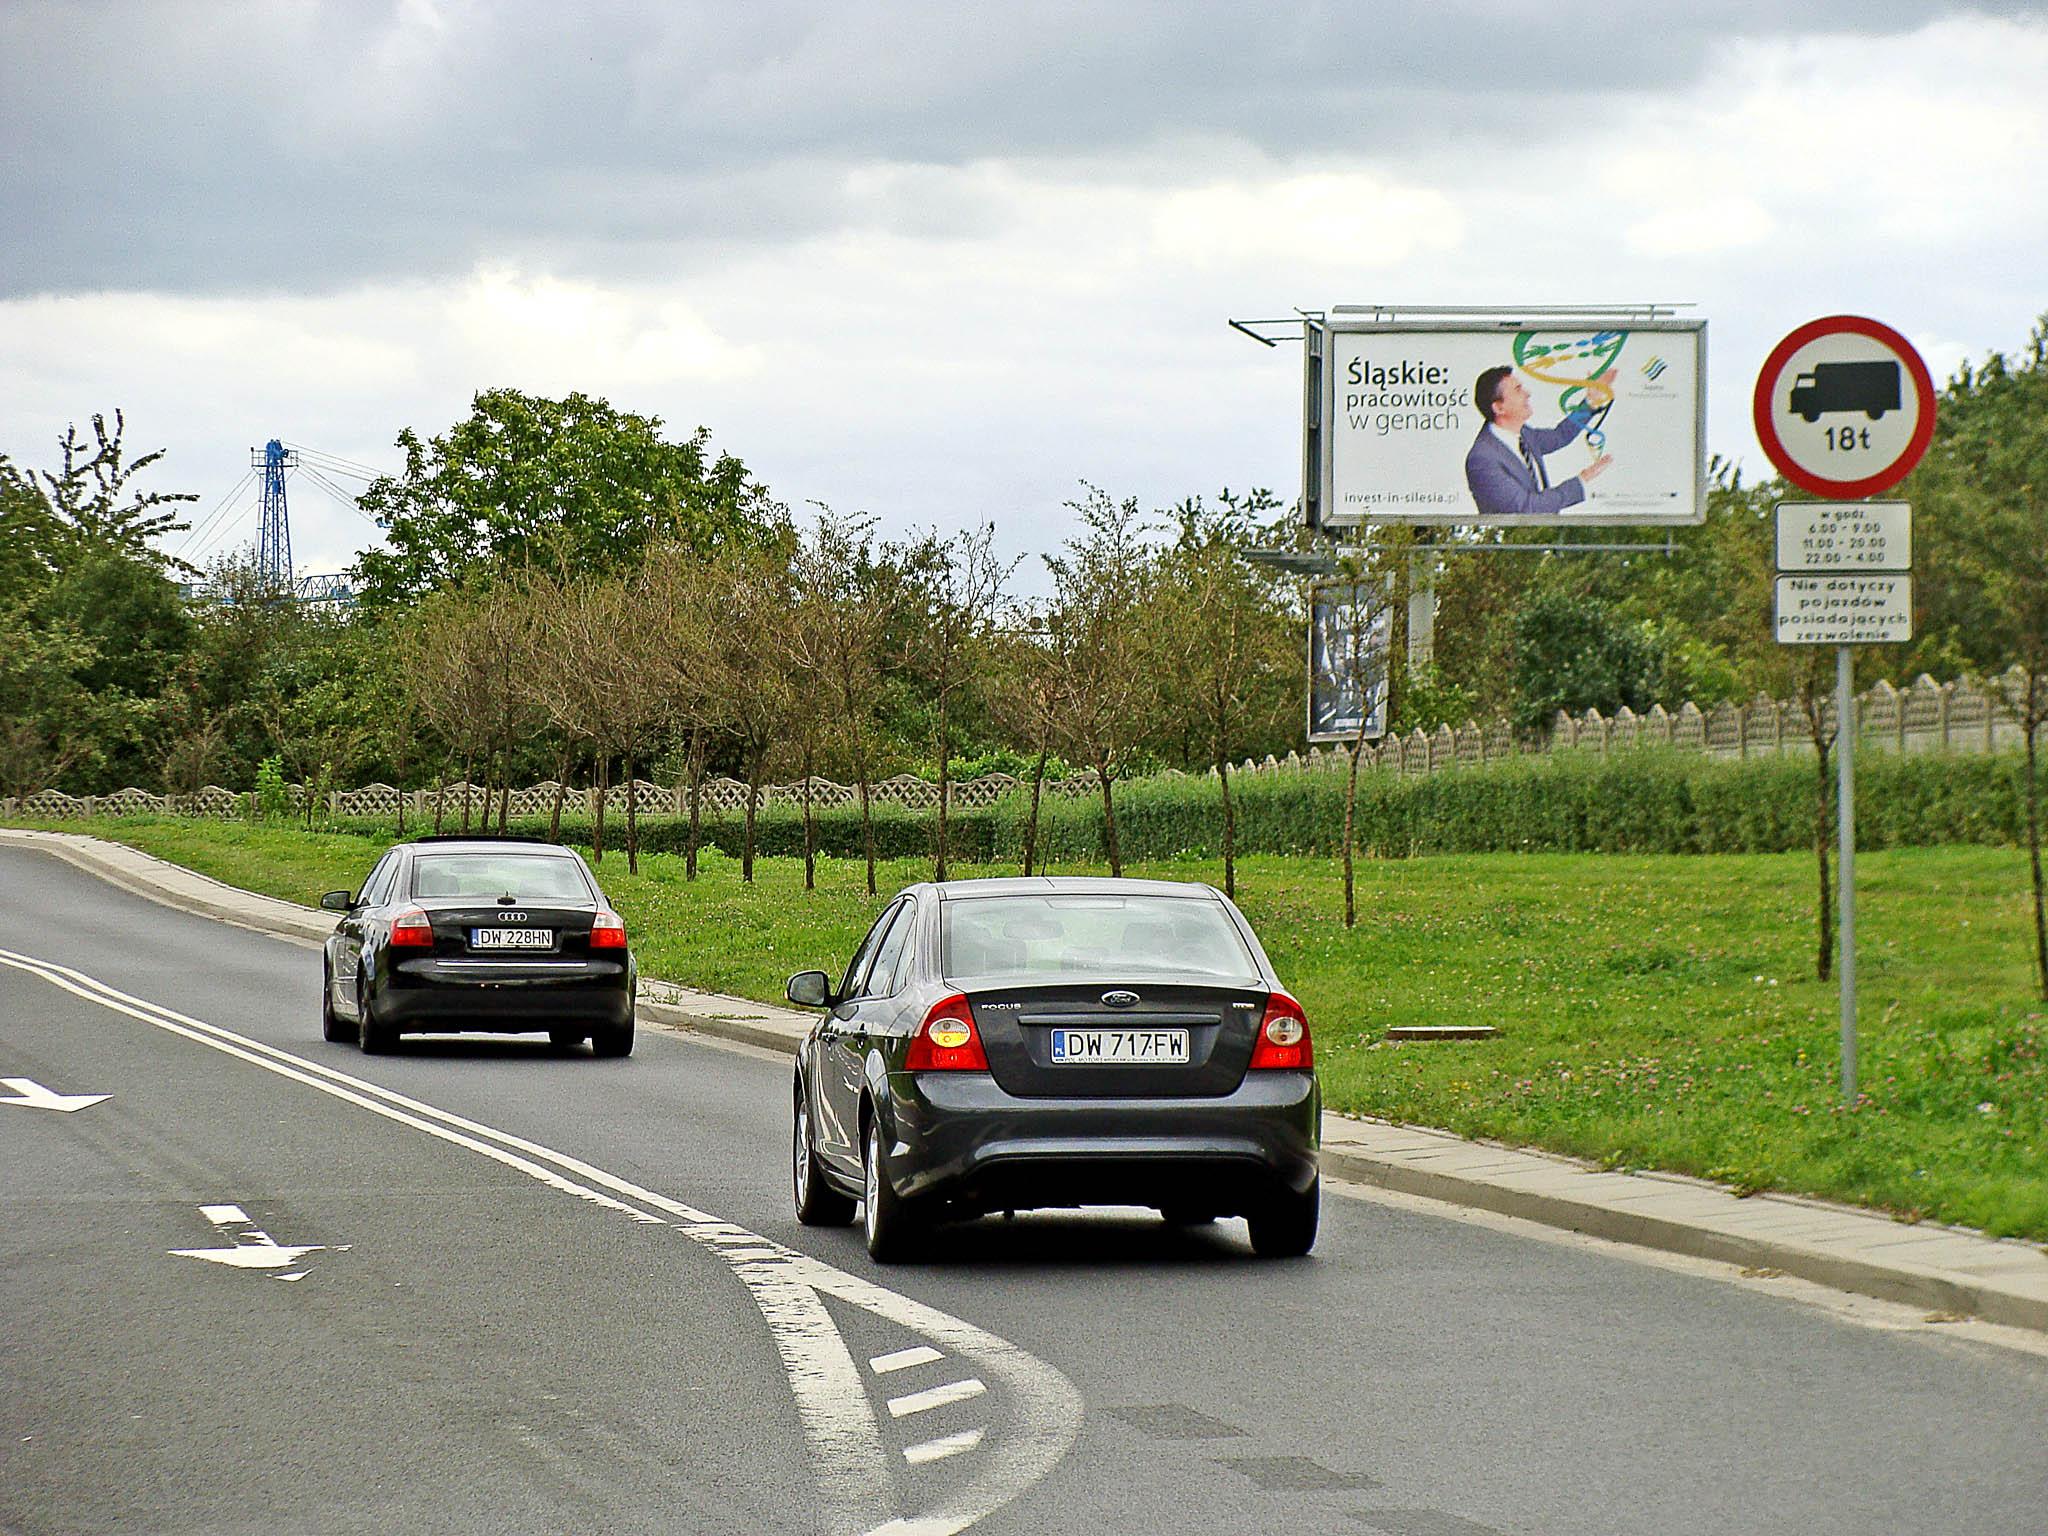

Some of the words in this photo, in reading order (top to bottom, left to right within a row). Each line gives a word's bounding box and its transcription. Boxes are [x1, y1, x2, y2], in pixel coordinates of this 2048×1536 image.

[1347, 356, 1449, 391] Śląskie:
[1346, 388, 1470, 412] pracowitość
[1349, 415, 1369, 430] w
[1375, 407, 1460, 437] genach
[1344, 491, 1460, 504] invest-in-silesia.pl
[1790, 580, 1819, 591] Nie
[1827, 580, 1896, 594] dotyczy
[1796, 629, 1890, 641] zezwolenie
[481, 930, 502, 944] DW
[507, 930, 550, 944] 228HN
[1068, 1033, 1102, 1056] DW
[1111, 1033, 1182, 1056] 717FW
